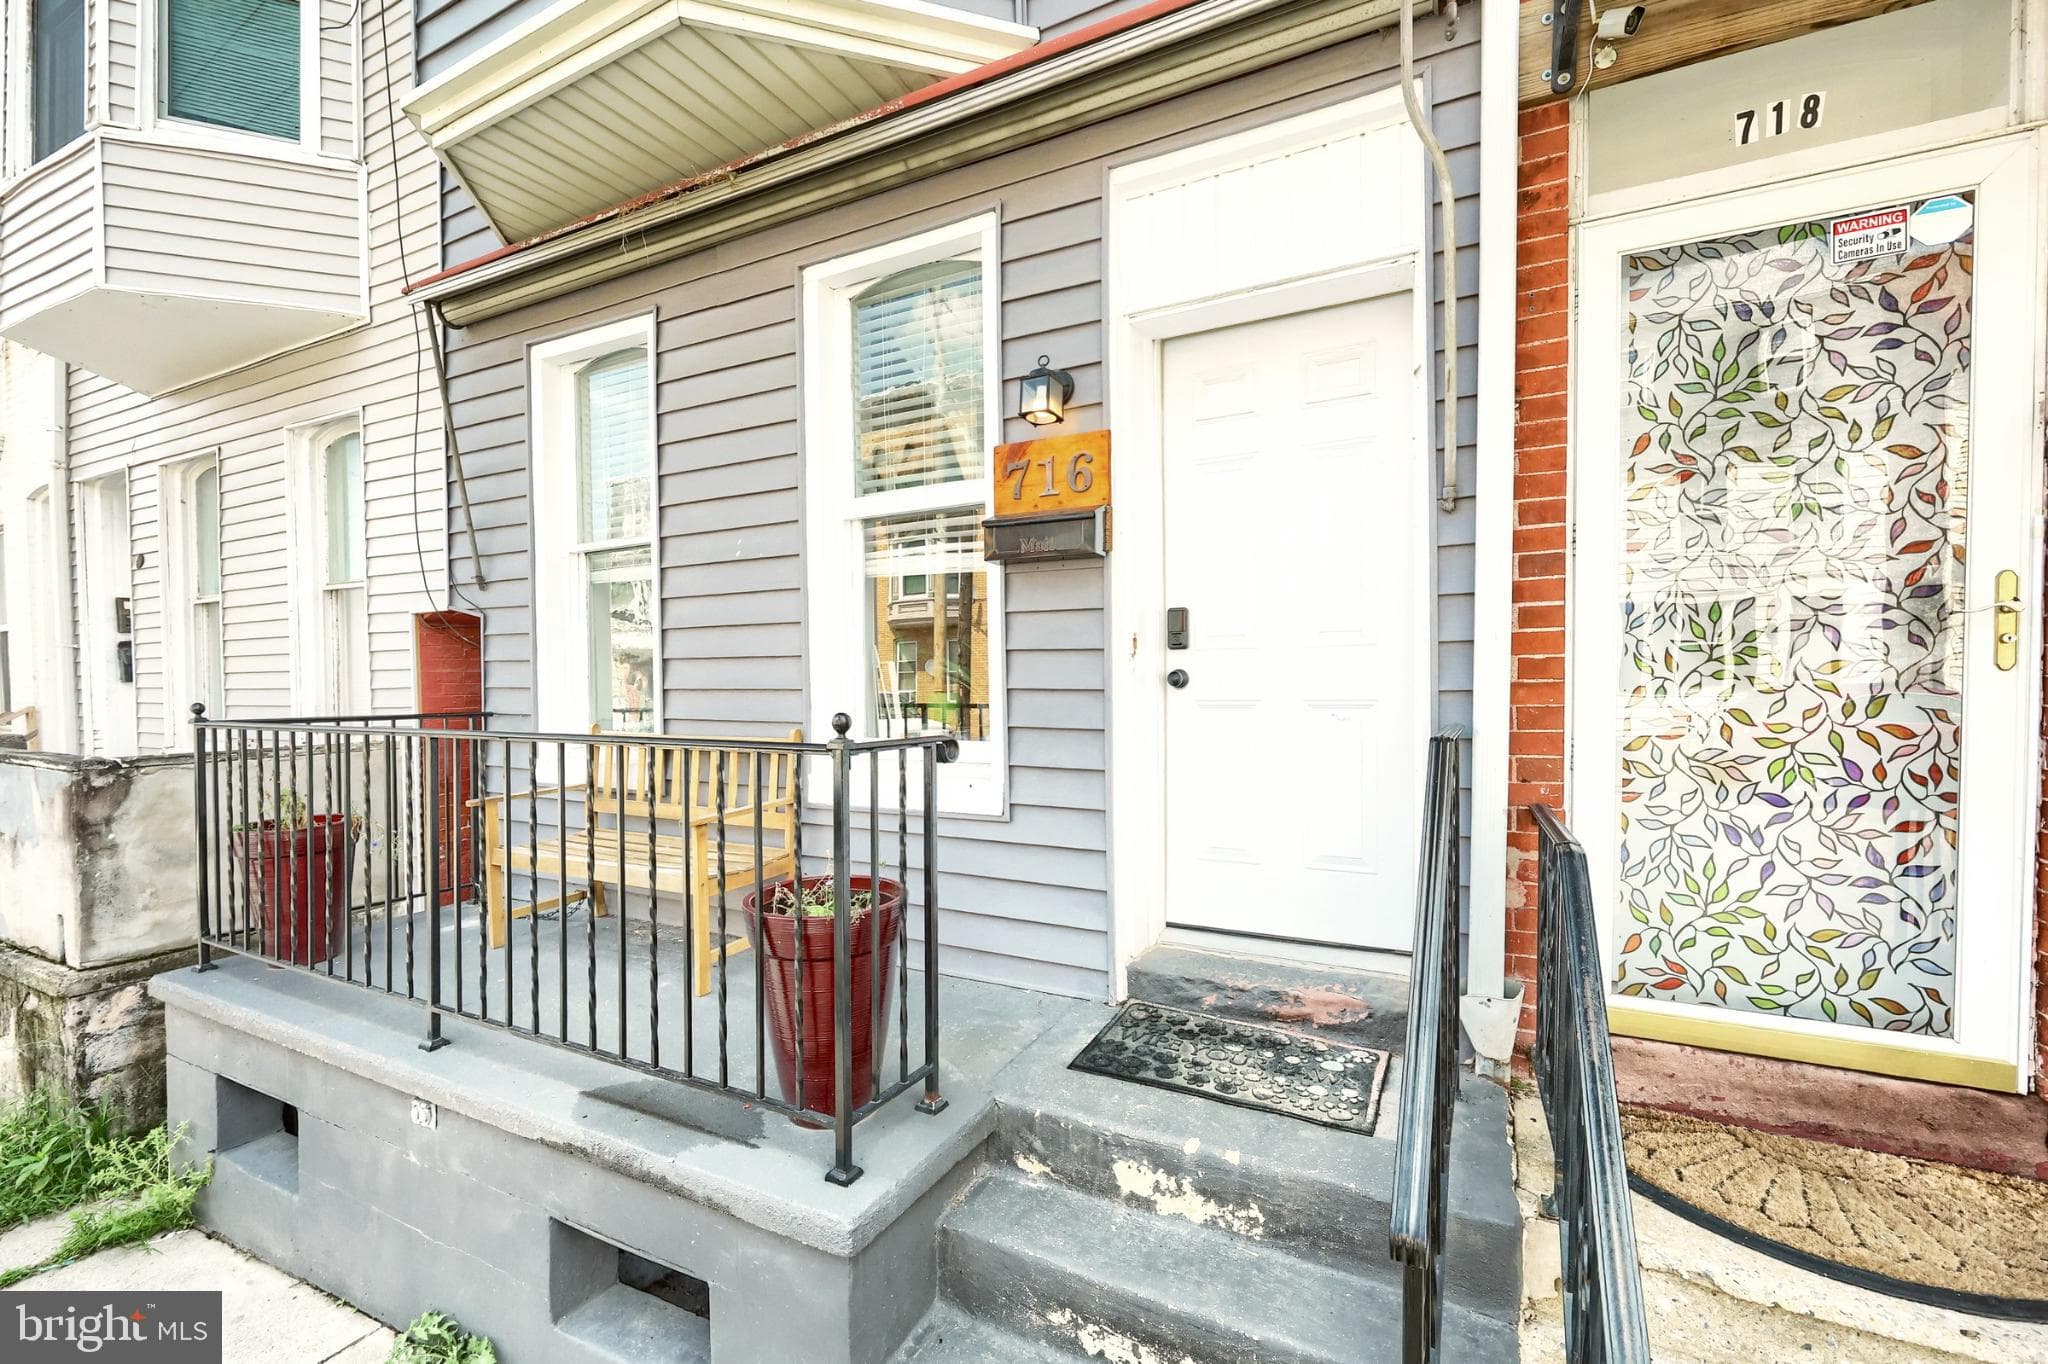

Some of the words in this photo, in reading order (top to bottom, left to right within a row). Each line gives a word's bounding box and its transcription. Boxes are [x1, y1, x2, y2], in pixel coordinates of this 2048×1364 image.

[1736, 94, 1820, 144] 718
[1837, 212, 1903, 234] WARNING
[1838, 234, 1874, 248] Security
[1838, 247, 1874, 260] Cameras
[1876, 243, 1886, 253] In
[1887, 241, 1903, 251] Use
[1006, 453, 1093, 500] 716
[1019, 536, 1056, 554] Mail
[1120, 1026, 1183, 1052] WIPE
[1190, 1041, 1269, 1071] YOUR
